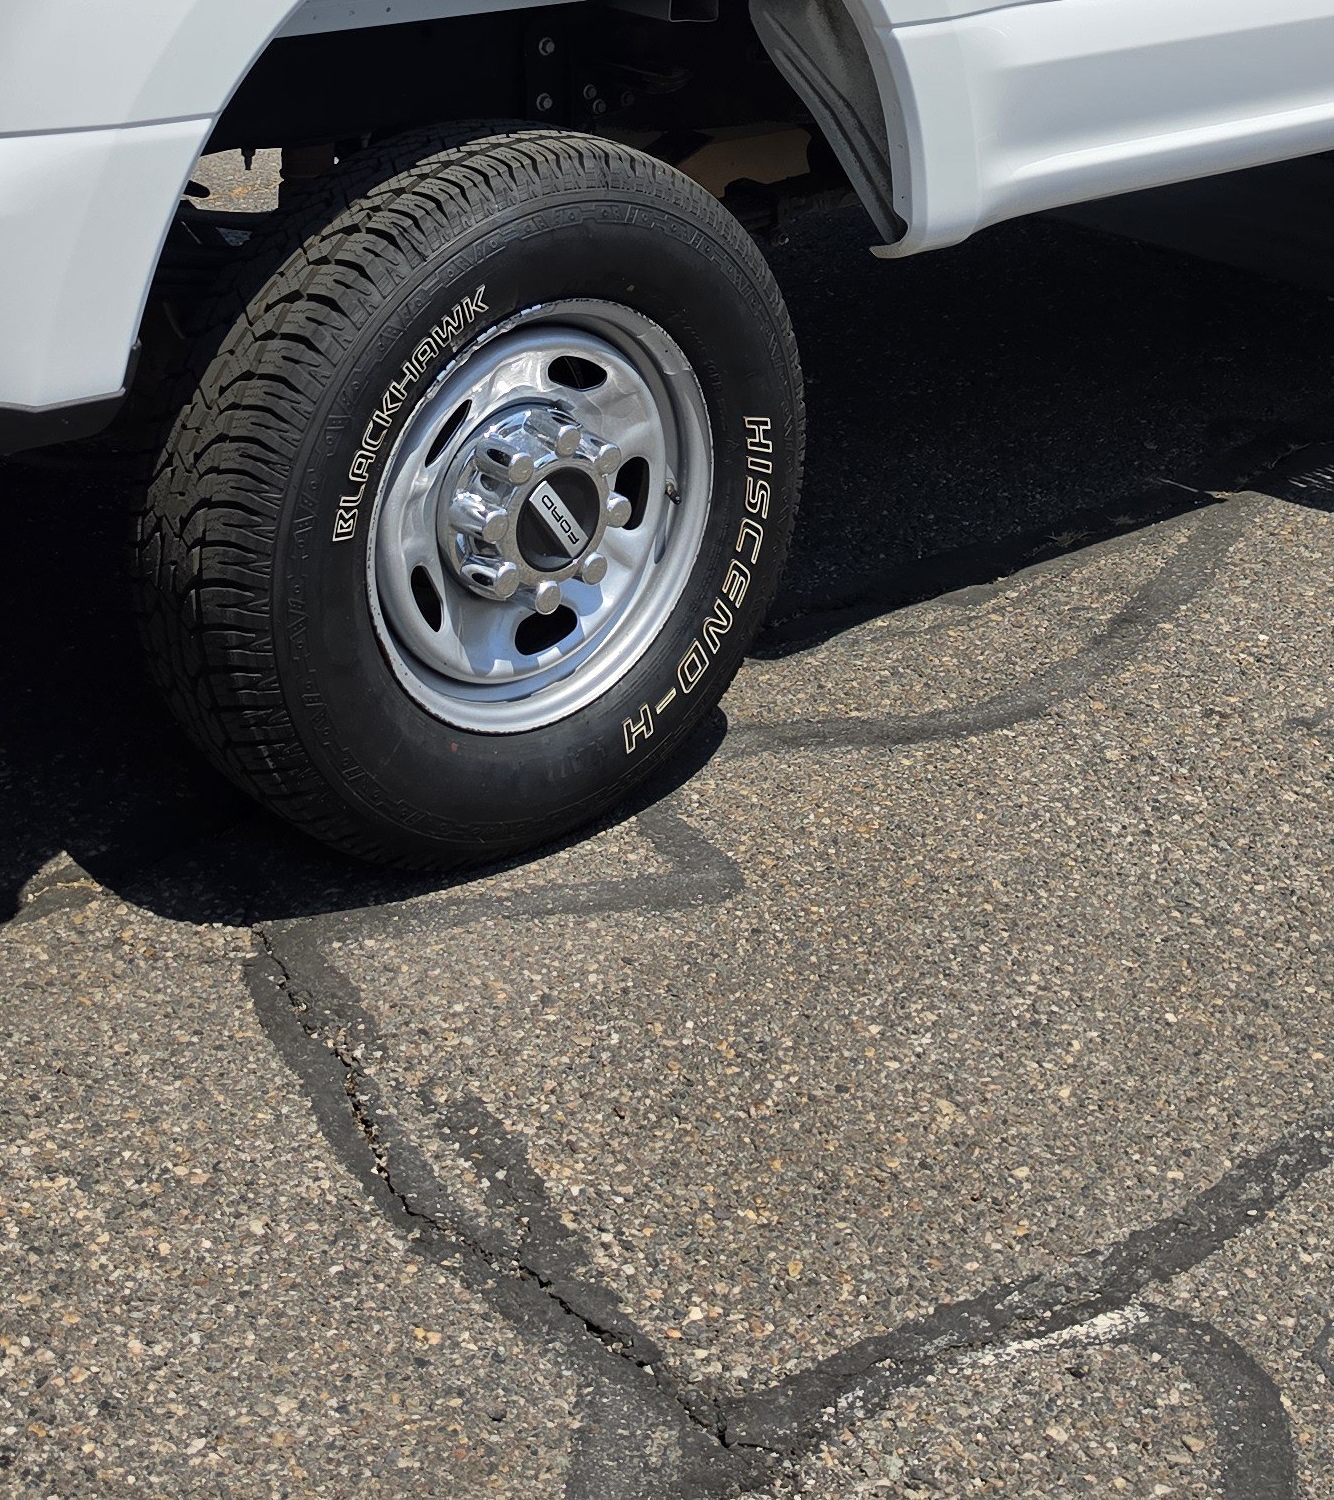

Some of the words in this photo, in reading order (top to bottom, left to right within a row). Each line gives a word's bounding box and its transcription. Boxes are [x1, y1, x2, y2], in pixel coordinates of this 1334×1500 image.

[333, 285, 489, 542] BLACKHAWK
[542, 495, 579, 545] FORD
[622, 416, 774, 754] HISCEND-H
